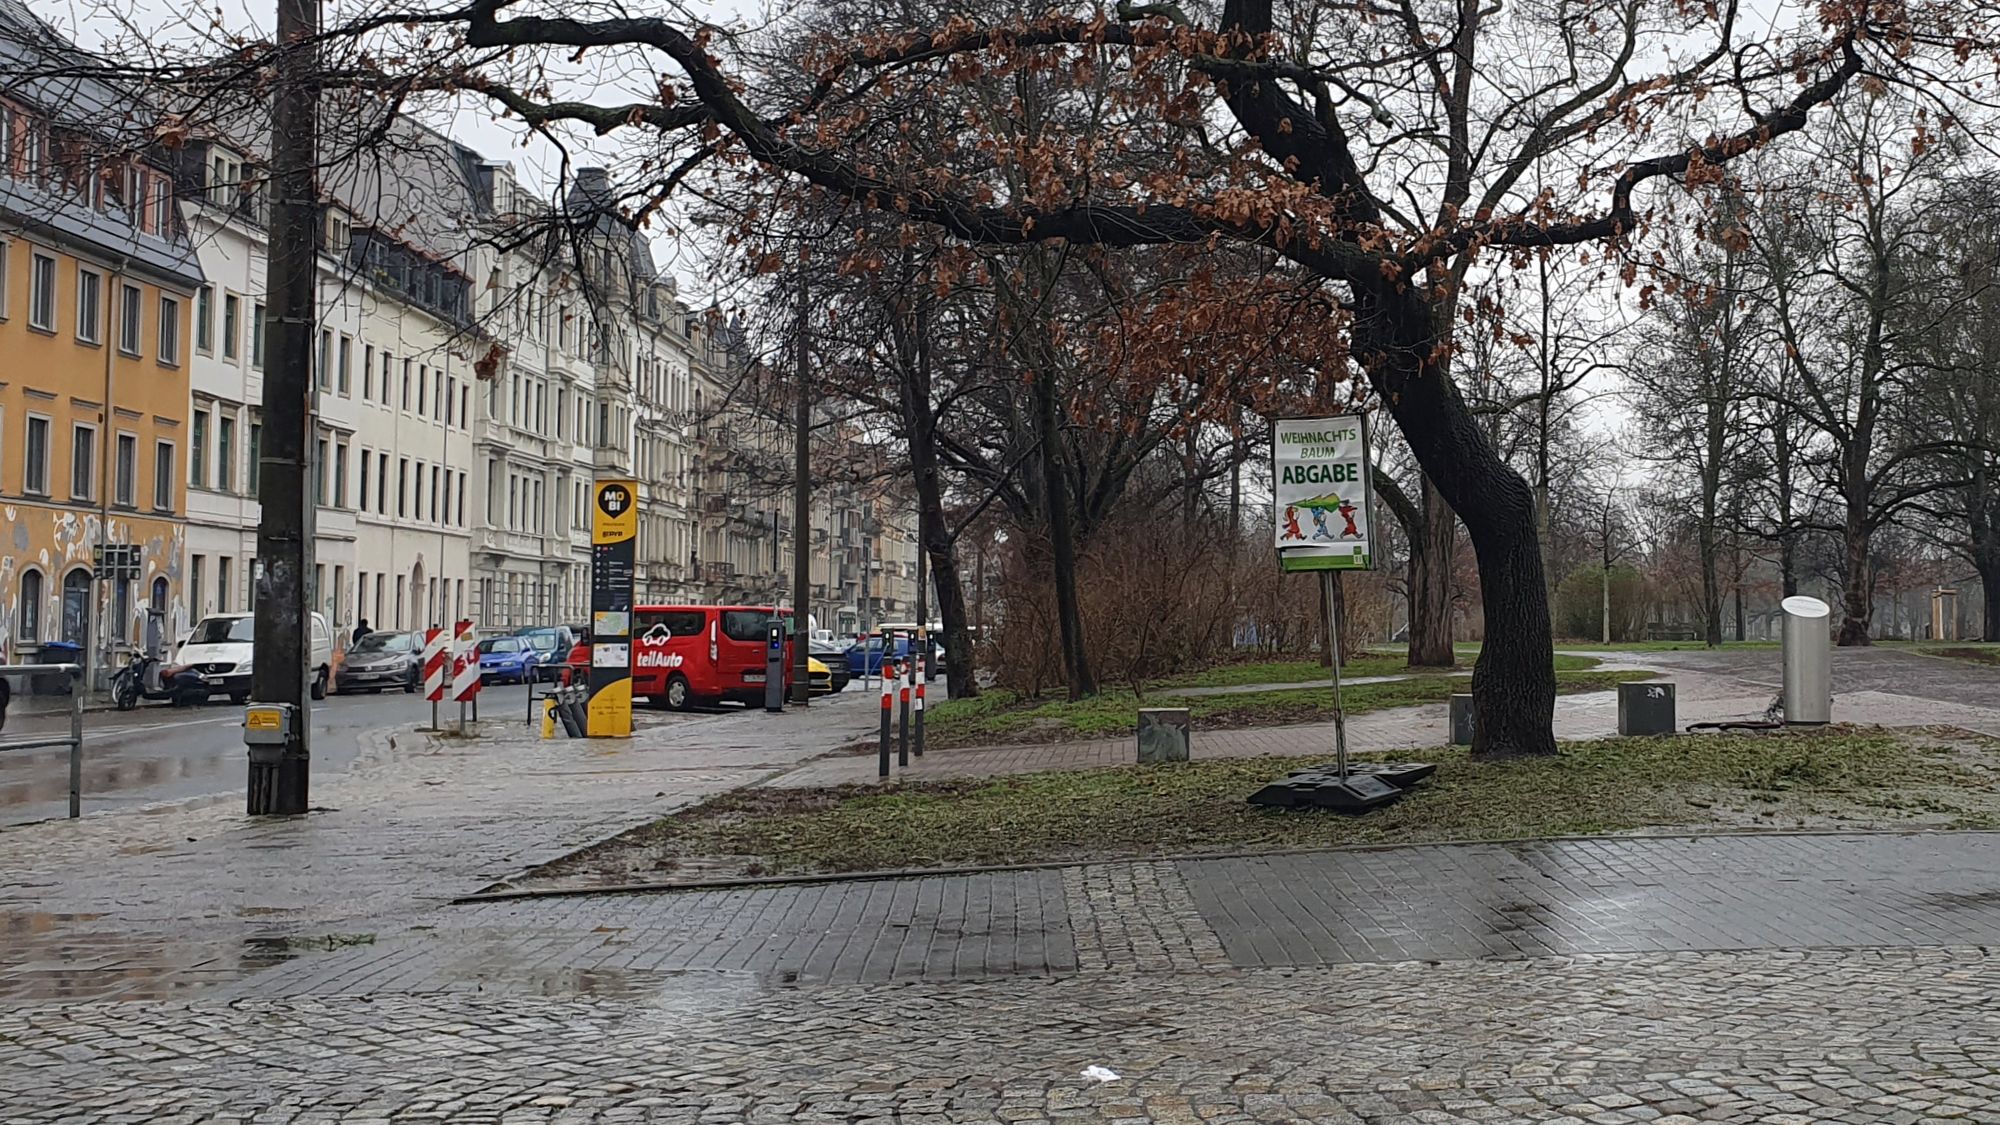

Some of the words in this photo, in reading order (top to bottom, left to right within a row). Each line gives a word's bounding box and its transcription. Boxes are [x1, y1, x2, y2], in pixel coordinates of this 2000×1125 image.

[1280, 429, 1356, 443] WEIHNACHTS
[1300, 447, 1336, 458] BAUM
[1282, 463, 1358, 484] ABGABE
[604, 491, 625, 501] MO
[608, 501, 621, 511] BI
[637, 651, 683, 667] teilAuto
